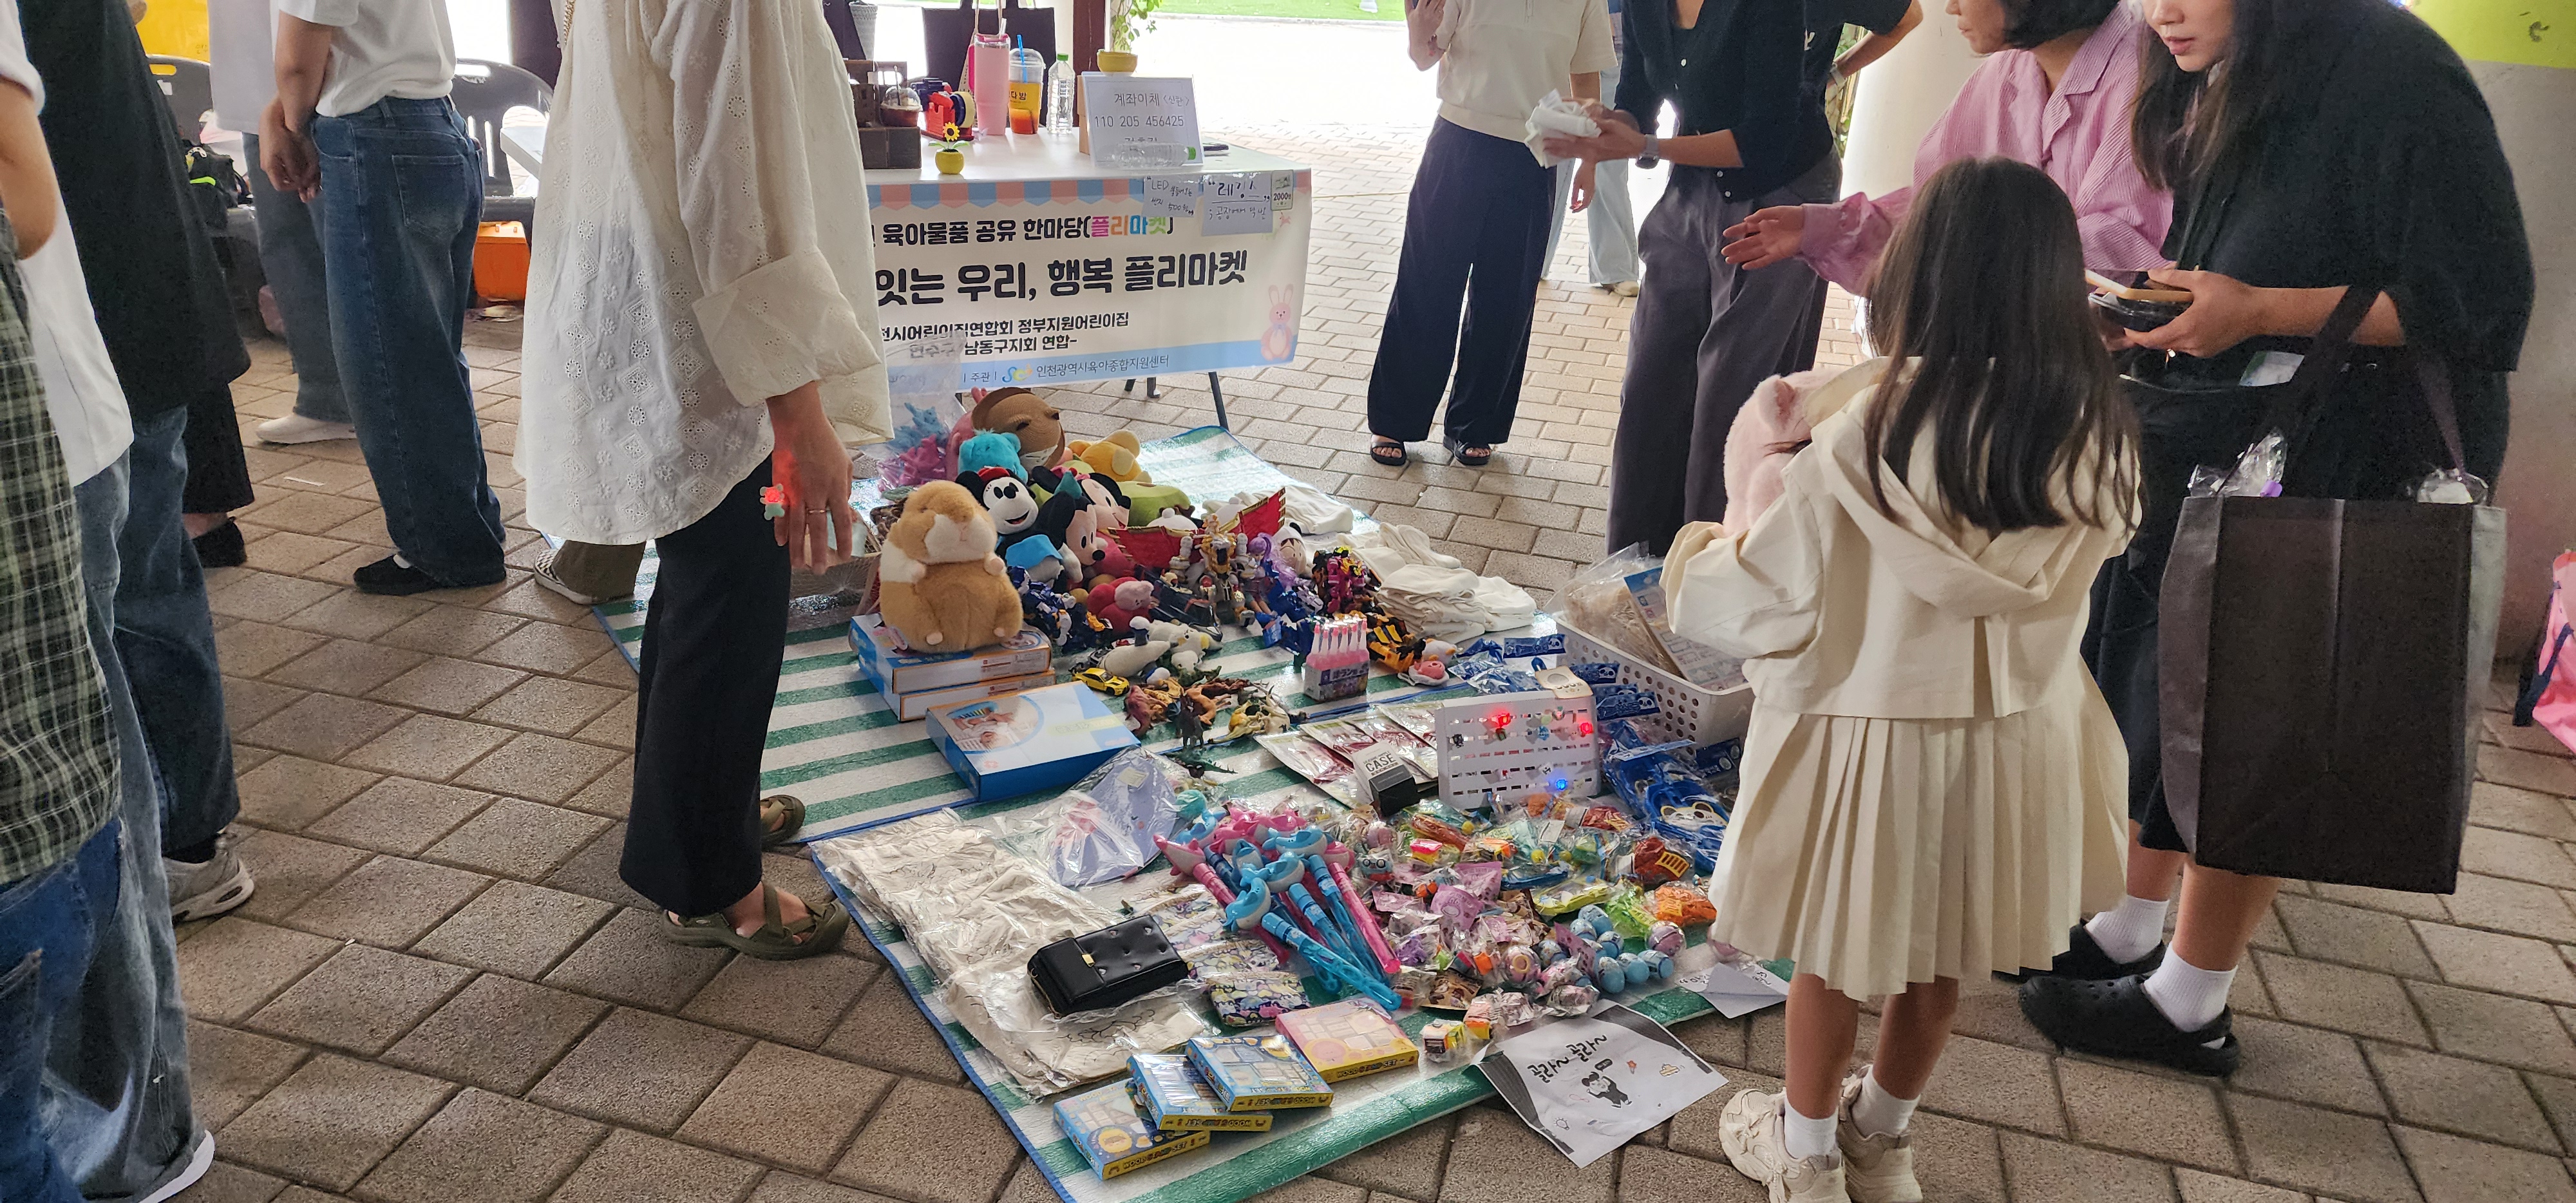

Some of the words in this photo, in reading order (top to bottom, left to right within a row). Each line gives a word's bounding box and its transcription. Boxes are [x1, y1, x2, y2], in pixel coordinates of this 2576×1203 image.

[1009, 91, 1027, 100] 다방
[1113, 93, 1160, 107] 계좌이체
[1095, 115, 1114, 128] 110
[1119, 115, 1139, 128] 205
[1146, 115, 1184, 128] 456425
[882, 223, 969, 247] 육아물품
[976, 221, 1016, 243] 공유
[1023, 215, 1175, 241] 한마당(플리마켓)
[957, 262, 1037, 302] 우리,
[1048, 258, 1113, 296] 행복
[1124, 250, 1247, 292] 플리마켓
[1018, 312, 1130, 335] 정부지원어린이집
[964, 337, 1037, 356] 남동구지회
[970, 370, 990, 383] 주관
[1036, 354, 1170, 379] 인천광역시육아종합지원센터
[1365, 753, 1397, 772] CASE
[1383, 1059, 1397, 1068] SET
[1527, 1056, 1569, 1084] 골라~
[1565, 1034, 1607, 1063] 골라~
[1171, 1141, 1188, 1152] SET
